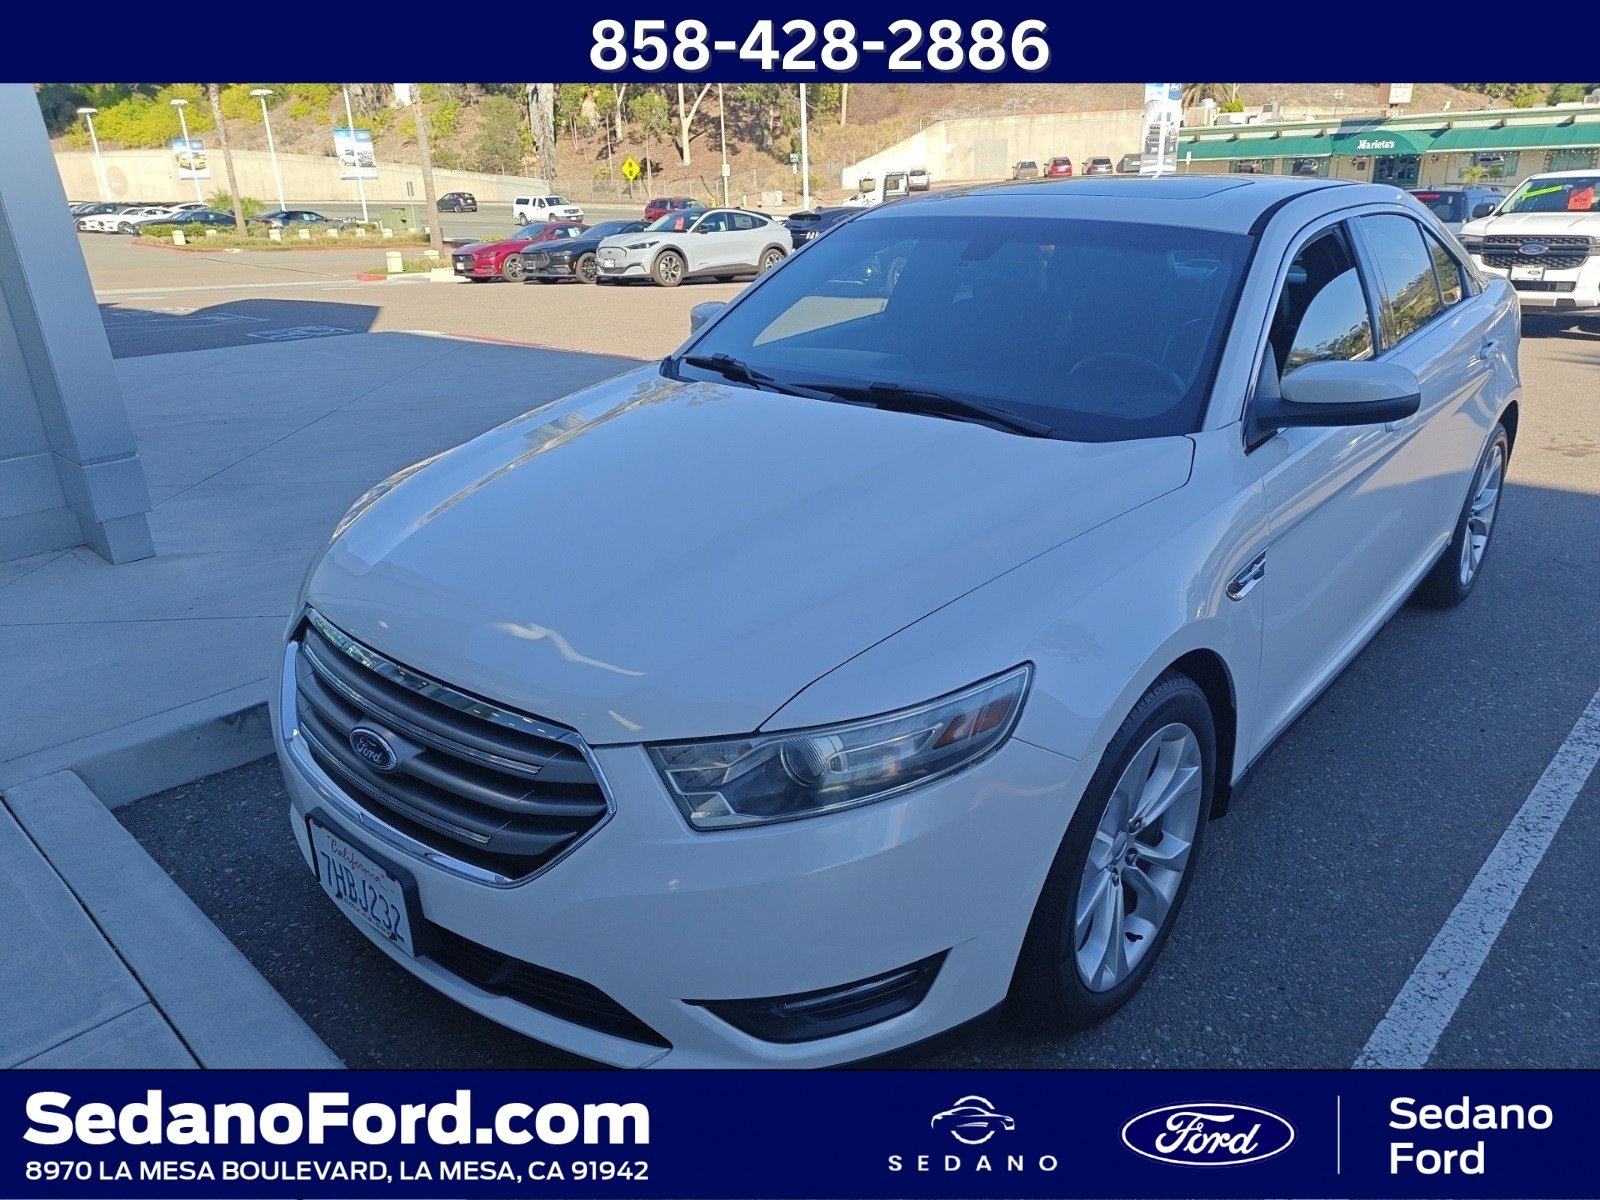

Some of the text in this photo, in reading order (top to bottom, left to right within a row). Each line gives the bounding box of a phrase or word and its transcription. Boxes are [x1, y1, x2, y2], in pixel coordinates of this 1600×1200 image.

[1357, 139, 1396, 150] Marieta's
[356, 736, 382, 763] Ford
[331, 838, 387, 891] California
[320, 850, 405, 942] 7HBJ232
